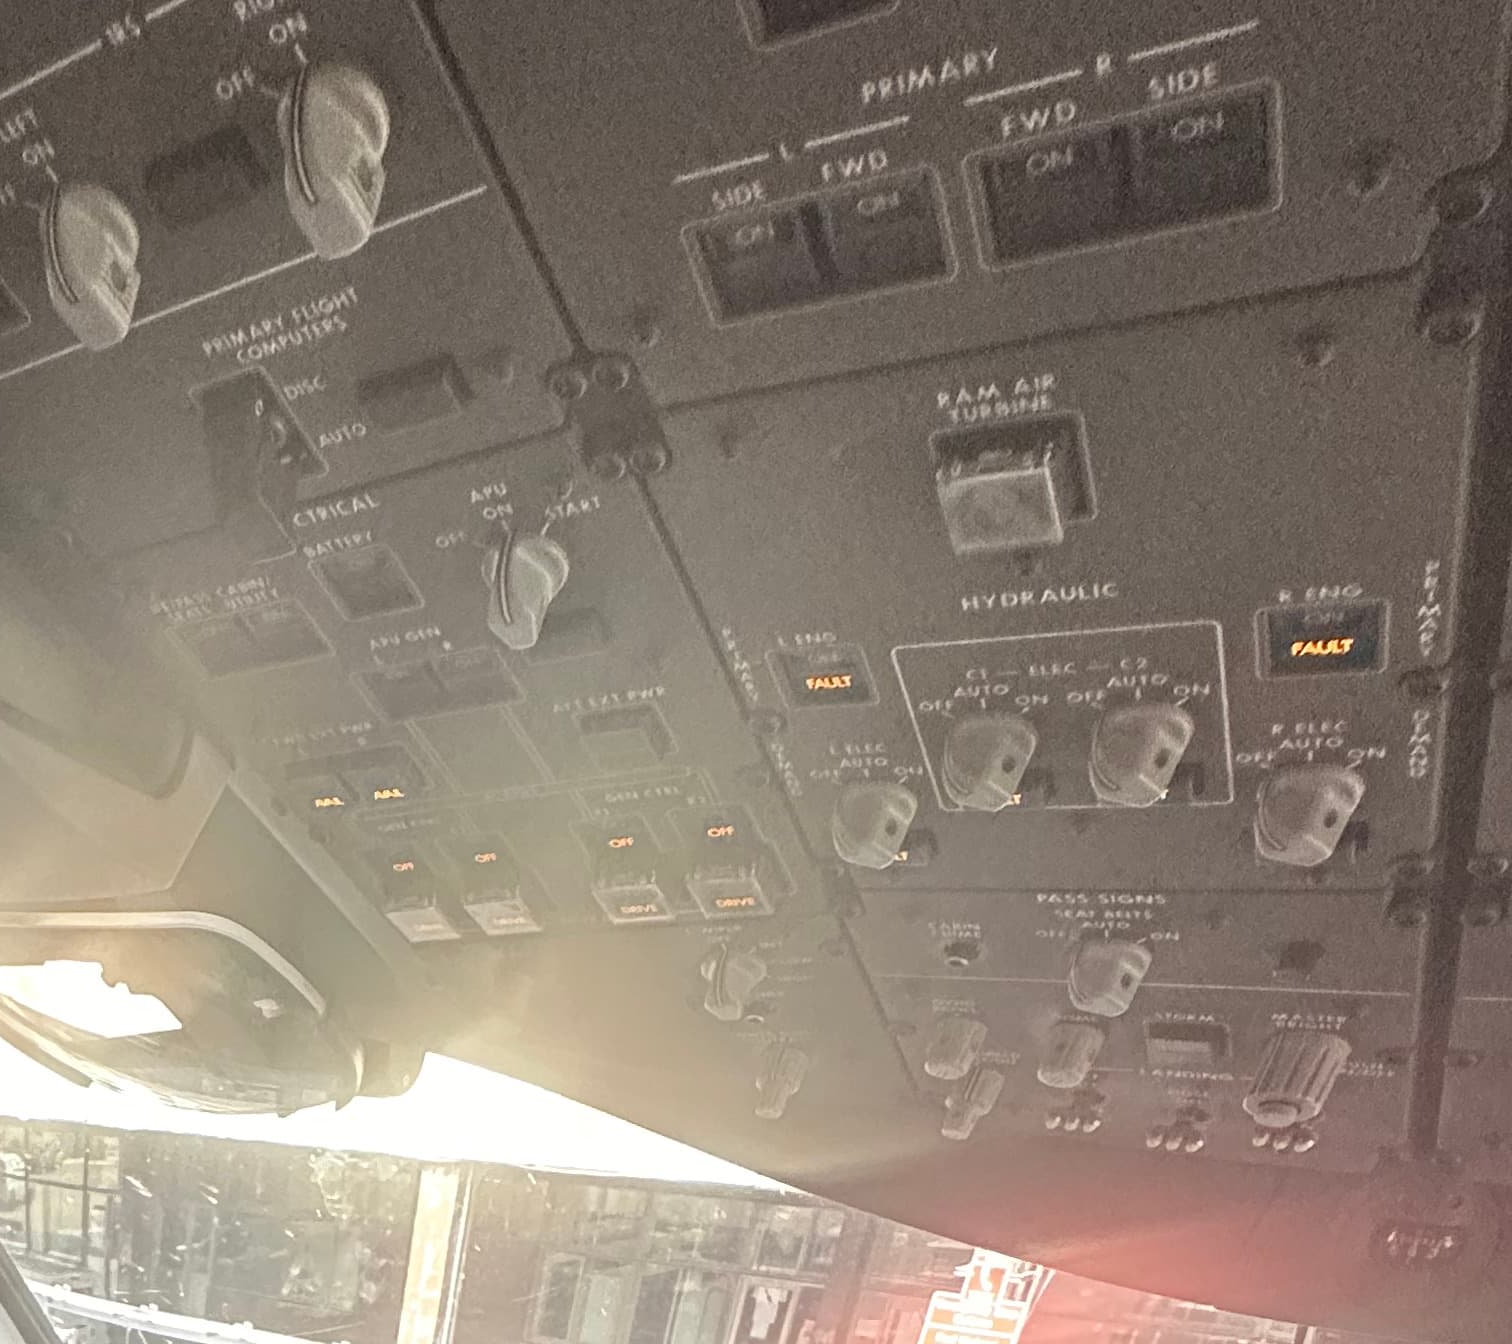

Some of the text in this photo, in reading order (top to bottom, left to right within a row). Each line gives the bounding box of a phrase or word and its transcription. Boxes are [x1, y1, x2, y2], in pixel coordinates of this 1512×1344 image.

[215, 67, 256, 100] OFF
[861, 47, 1000, 105] PRIMARY
[1148, 61, 1220, 101] SIDE
[1000, 100, 1078, 141] FWD
[1169, 110, 1225, 143] ON
[820, 148, 888, 184] FWD
[712, 178, 767, 211] SIDE
[202, 287, 359, 356] PRIMARY FLIGHT
[236, 316, 349, 362] COMPUTERS
[283, 376, 327, 403] DISC
[937, 374, 1056, 408] RAM AIR
[318, 422, 367, 448] AUTO
[292, 493, 380, 528] CTRICAL
[543, 496, 600, 521] START
[961, 582, 1119, 612] HYDRAULIC
[1291, 637, 1354, 657] FAULT
[806, 674, 853, 690] FAULT
[609, 836, 634, 848] OFF
[707, 826, 734, 837] OFF
[715, 897, 756, 908] DRIVE
[1036, 893, 1166, 905] PASS SIGNS
